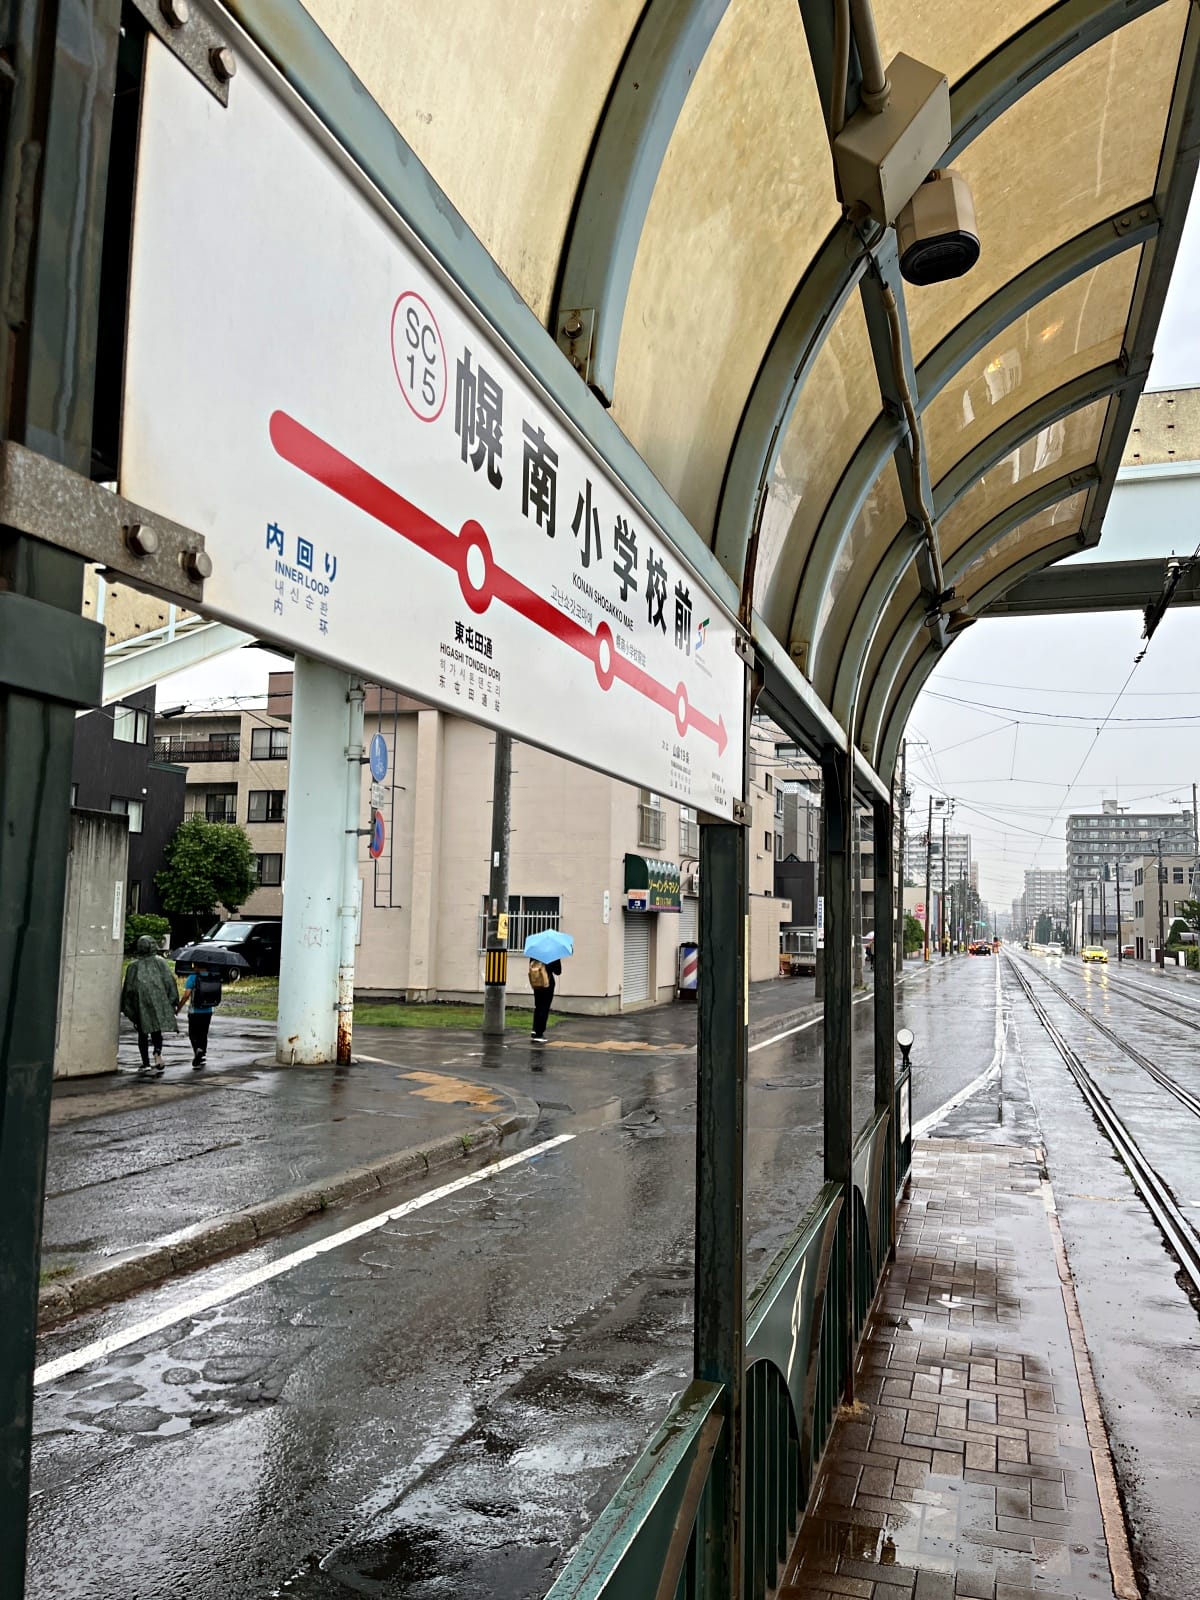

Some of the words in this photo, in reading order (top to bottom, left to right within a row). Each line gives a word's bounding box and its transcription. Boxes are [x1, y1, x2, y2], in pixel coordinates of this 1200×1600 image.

[405, 306, 437, 365] SC
[406, 353, 436, 407] 15
[454, 345, 693, 657] 幌南小学校前
[265, 521, 337, 582] 内回り
[275, 559, 304, 586] INNER
[305, 575, 330, 597] LOOP
[572, 572, 594, 600] KONAN
[594, 590, 623, 623] SHOGAKKO
[623, 613, 634, 632] MAE
[440, 642, 465, 664] HIGASHI
[464, 654, 488, 676] TONDEN
[487, 666, 501, 682] DORI
[454, 620, 493, 660] 東屯田通
